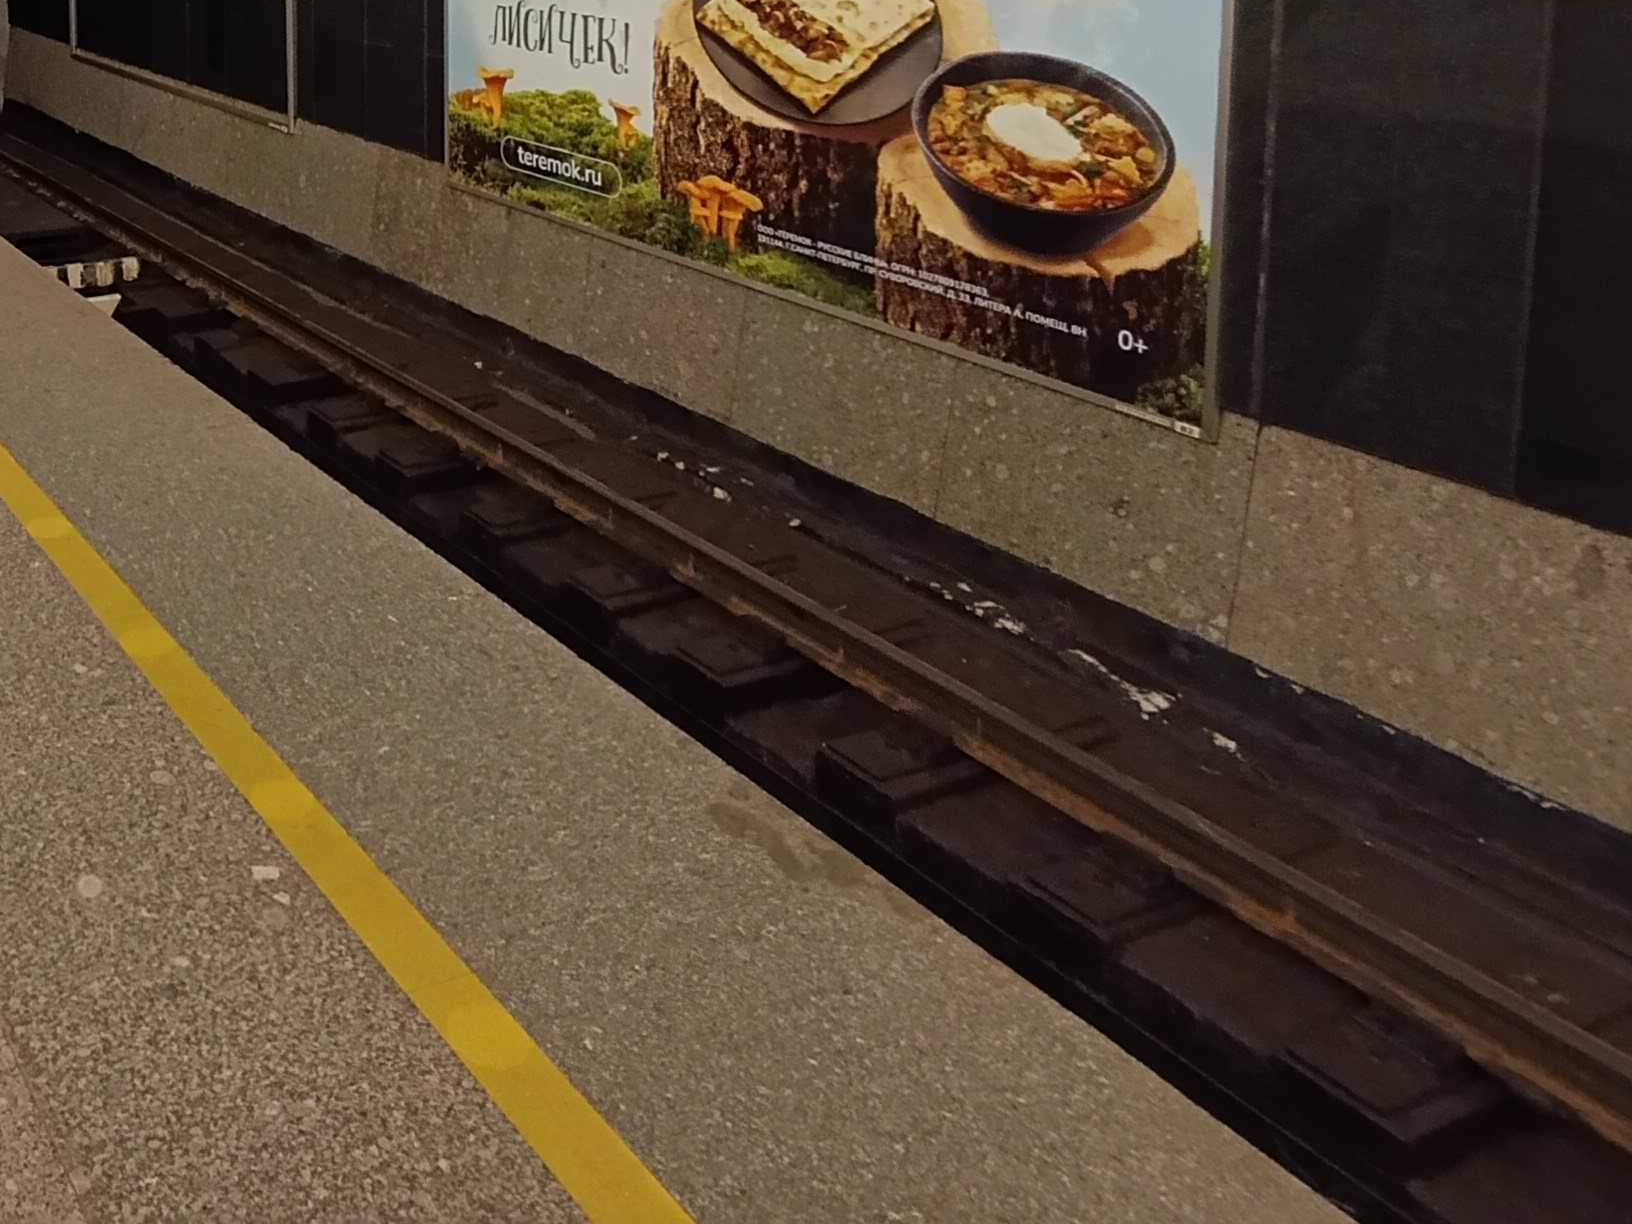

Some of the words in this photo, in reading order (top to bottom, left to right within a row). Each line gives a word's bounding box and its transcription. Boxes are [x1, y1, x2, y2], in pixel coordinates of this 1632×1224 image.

[488, 0, 630, 76] ЛИСИЧЕК!
[516, 145, 603, 187] teremok.ru
[974, 296, 1012, 315] ЛИТЕРА
[1117, 328, 1149, 355] 0+
